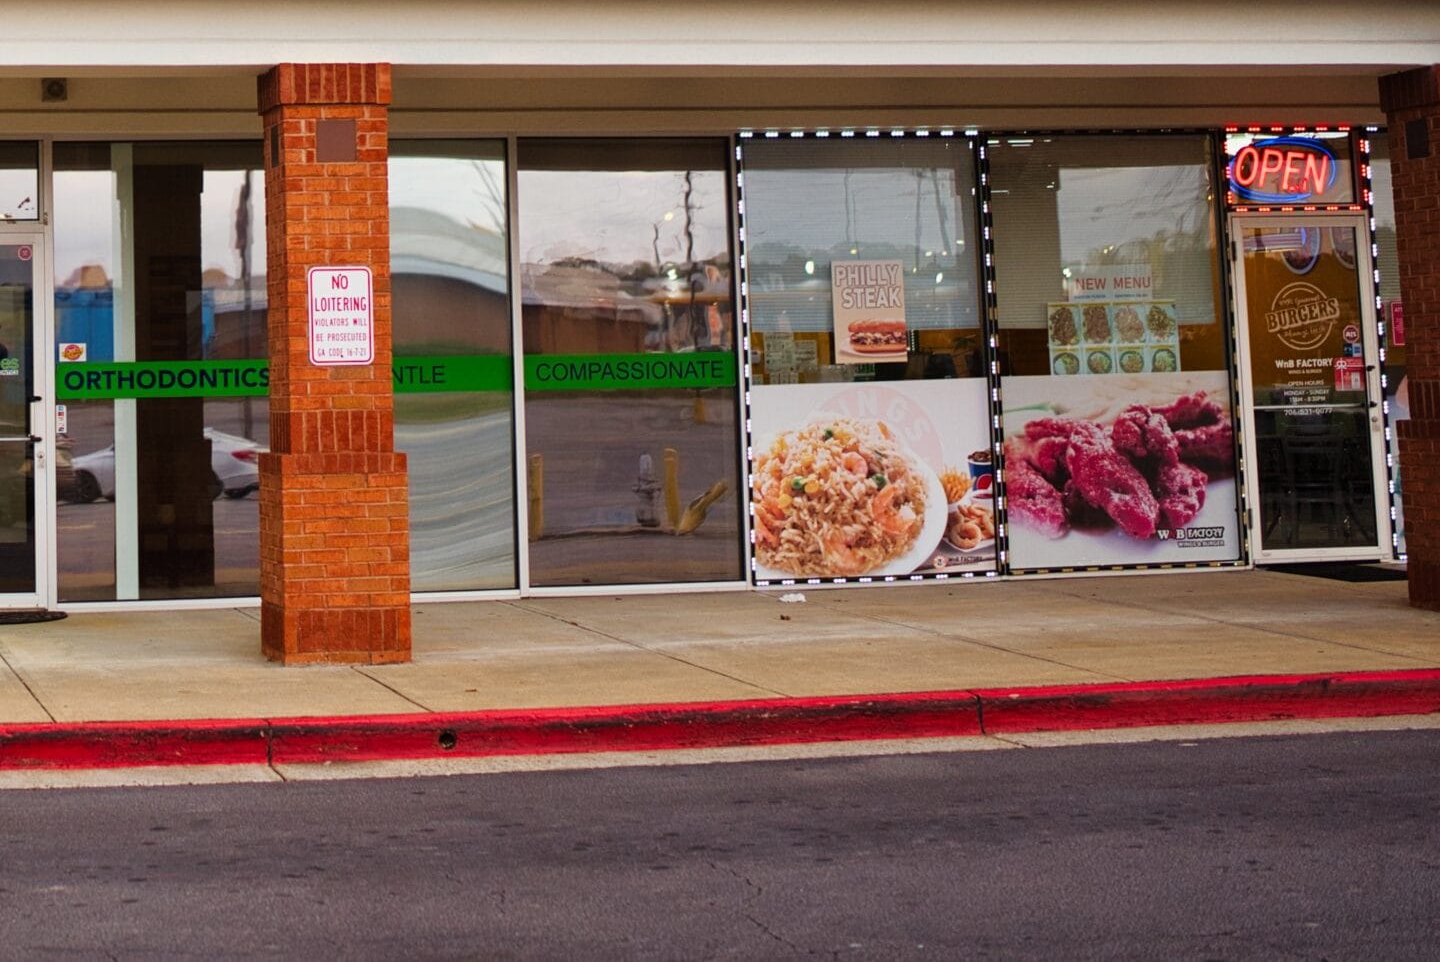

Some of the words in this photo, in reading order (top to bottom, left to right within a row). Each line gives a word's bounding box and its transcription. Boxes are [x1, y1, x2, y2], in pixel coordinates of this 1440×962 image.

[1235, 145, 1329, 196] OPEN
[331, 275, 349, 290] NO
[834, 264, 900, 288] PHILLY
[1074, 278, 1107, 291] NEW
[1114, 276, 1151, 290] MENU
[315, 296, 367, 312] LOITERING
[841, 286, 902, 309] STEAK
[314, 317, 349, 327] VIOLATORS
[352, 317, 367, 327] WILL
[1266, 298, 1339, 332] BURGERS
[315, 333, 324, 343] BE
[327, 332, 367, 342] PROSECUTED
[328, 348, 344, 357] CODE
[1275, 359, 1295, 369] WnB
[1296, 357, 1334, 368] FACTORY
[392, 365, 446, 385] NTLE
[535, 360, 724, 382] COMPASSIONATE
[64, 367, 269, 391] ORTHODONTICS
[1309, 388, 1330, 396] SUNDAY
[1157, 528, 1186, 540] WB
[1187, 527, 1223, 539] FACTORY
